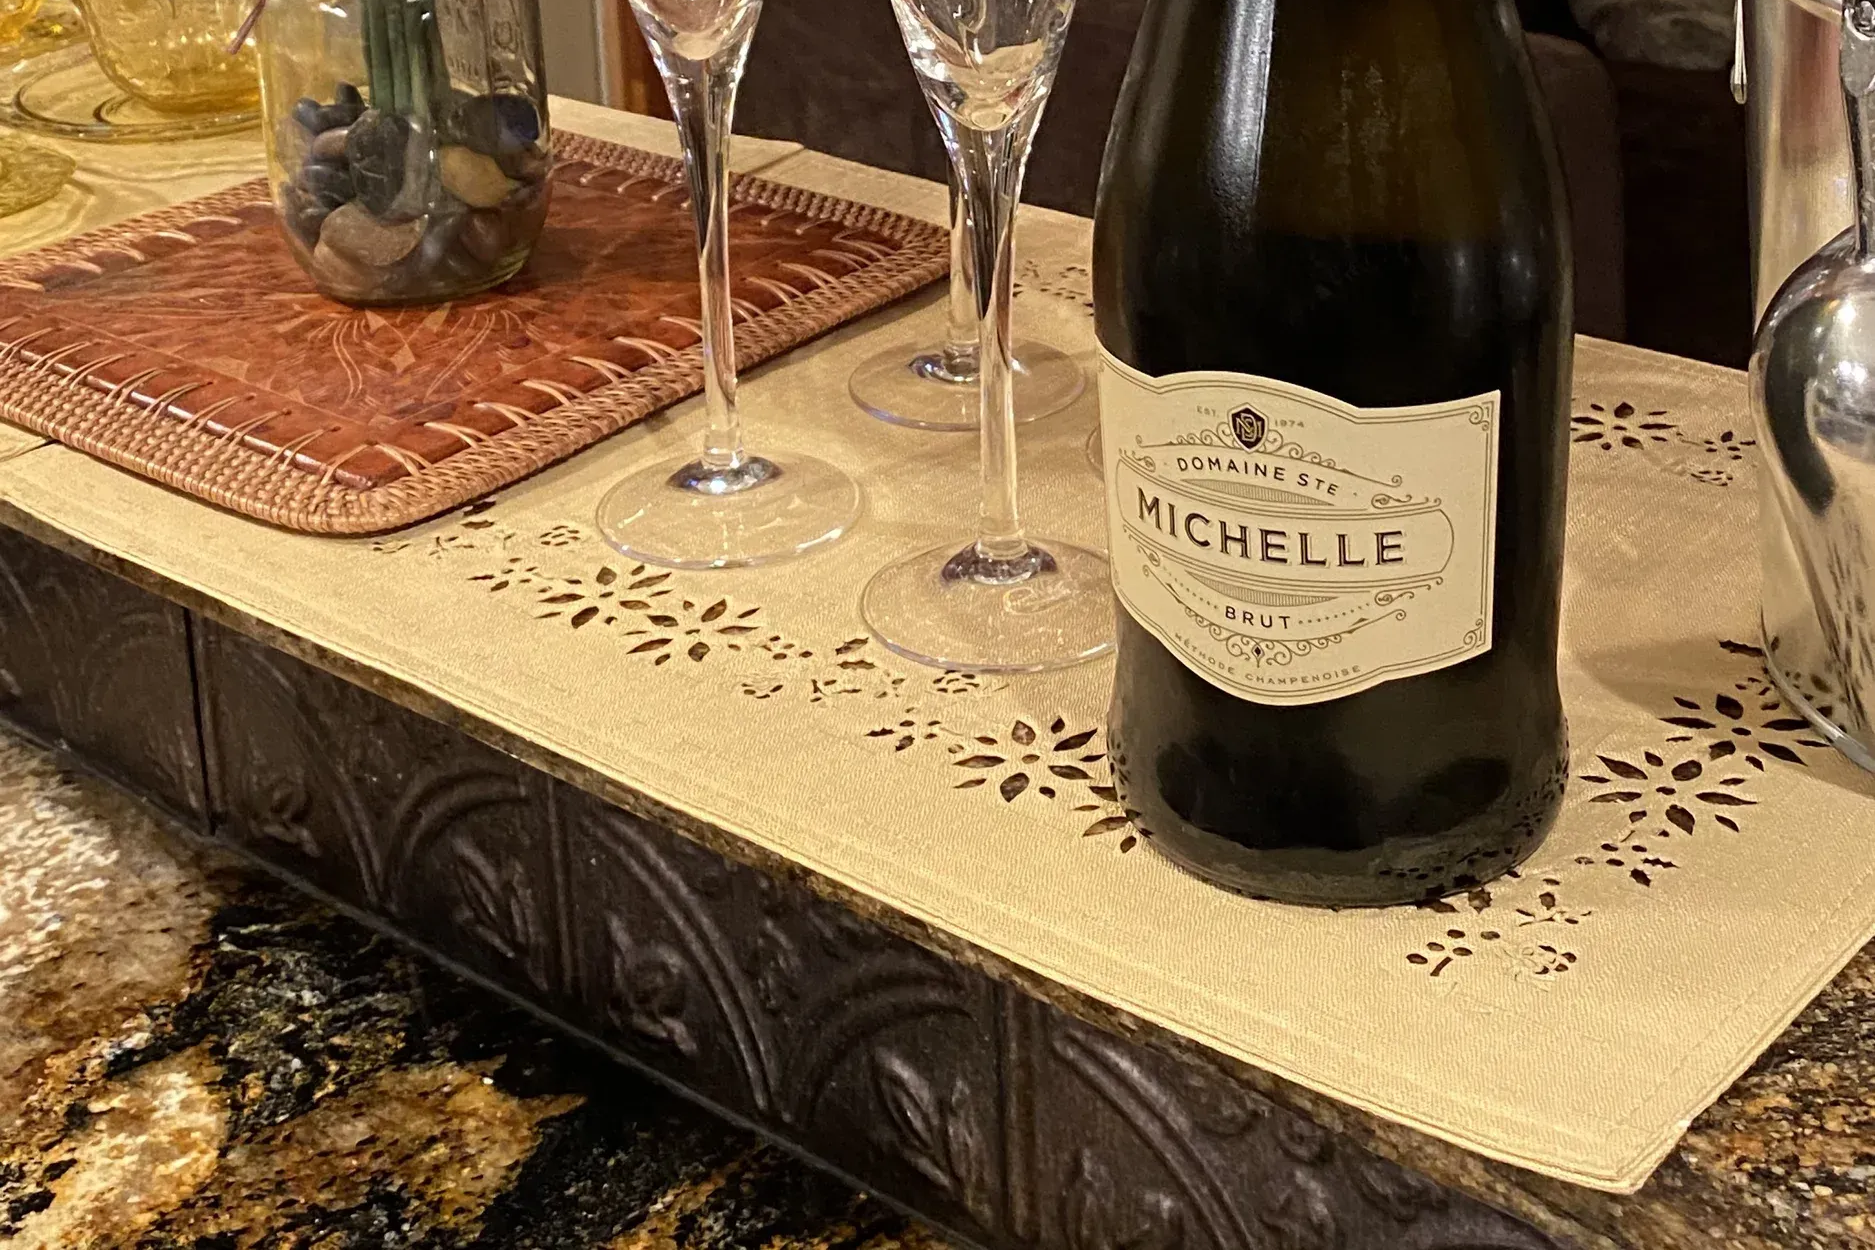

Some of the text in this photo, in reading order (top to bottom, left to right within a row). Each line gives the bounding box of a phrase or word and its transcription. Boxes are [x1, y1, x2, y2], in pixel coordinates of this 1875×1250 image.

[1274, 419, 1305, 429] 1974
[1176, 456, 1339, 497] DOMAINE STE
[1137, 486, 1406, 567] MICHELLE
[1225, 605, 1291, 630] BRUT
[1244, 664, 1361, 686] CHAMPENOISE
